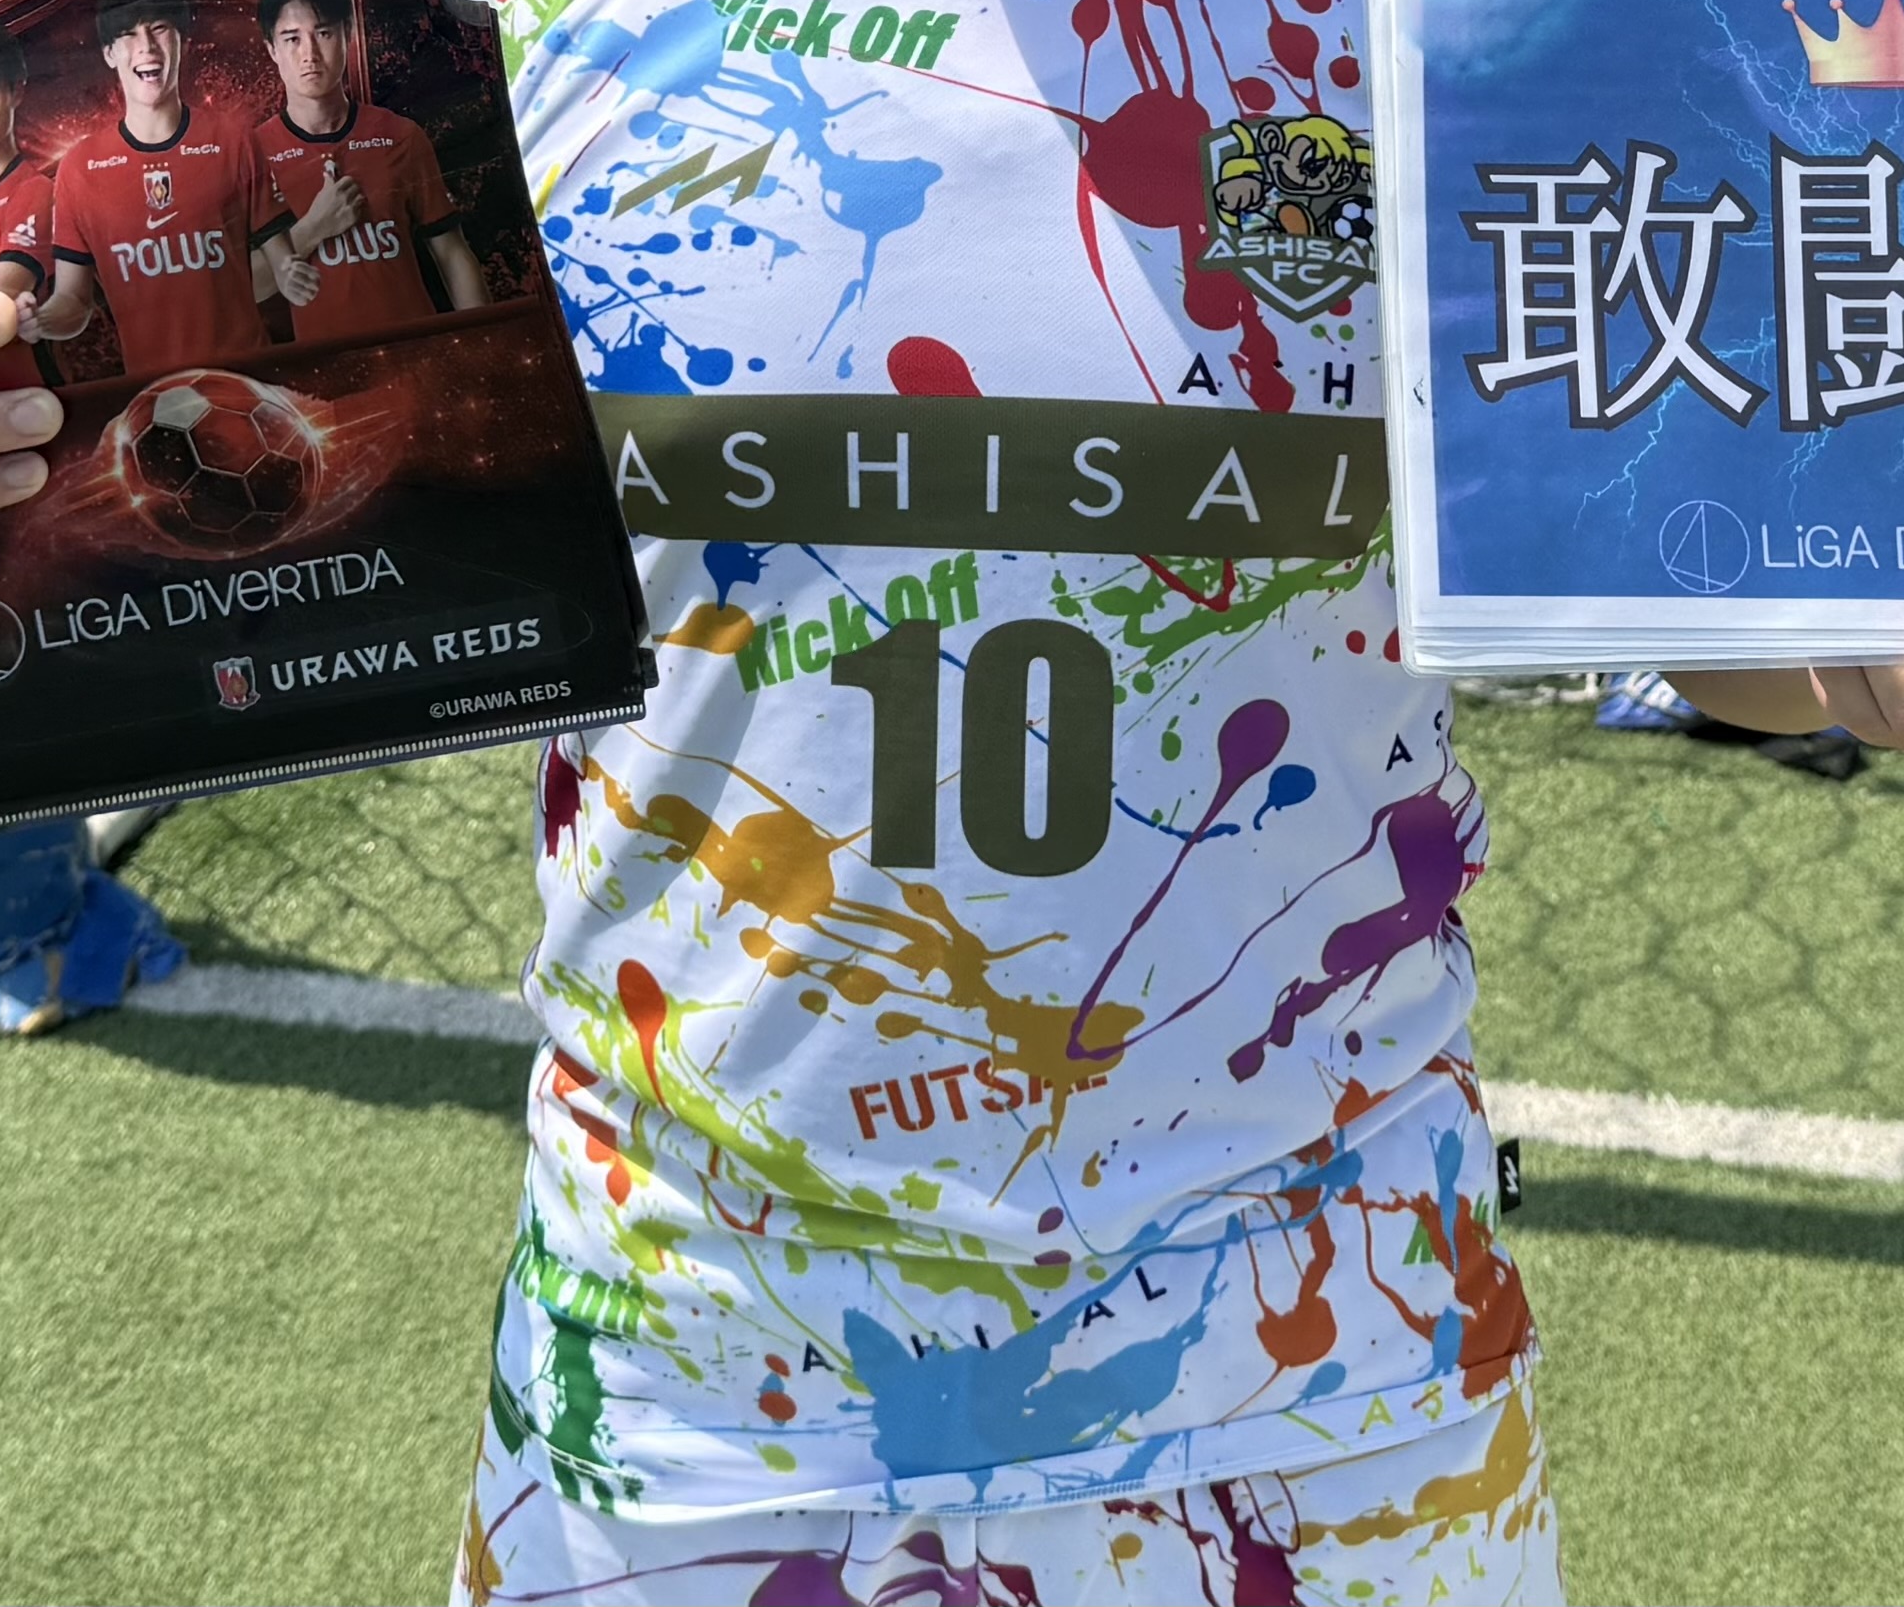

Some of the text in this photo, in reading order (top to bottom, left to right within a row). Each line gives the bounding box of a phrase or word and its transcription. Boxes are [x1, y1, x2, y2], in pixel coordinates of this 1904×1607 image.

[849, 5, 961, 70] Off
[110, 230, 226, 283] POLUS
[317, 220, 400, 267] OLUS
[1203, 236, 1375, 271] ASHISA
[1272, 261, 1325, 285] FC
[615, 429, 1354, 527] ASHISAL
[735, 550, 980, 693] Kick Off
[270, 618, 542, 693] URAWA REDS
[519, 680, 572, 706] REDS
[830, 618, 1115, 877] 10
[849, 1056, 1108, 1141] FUTS
